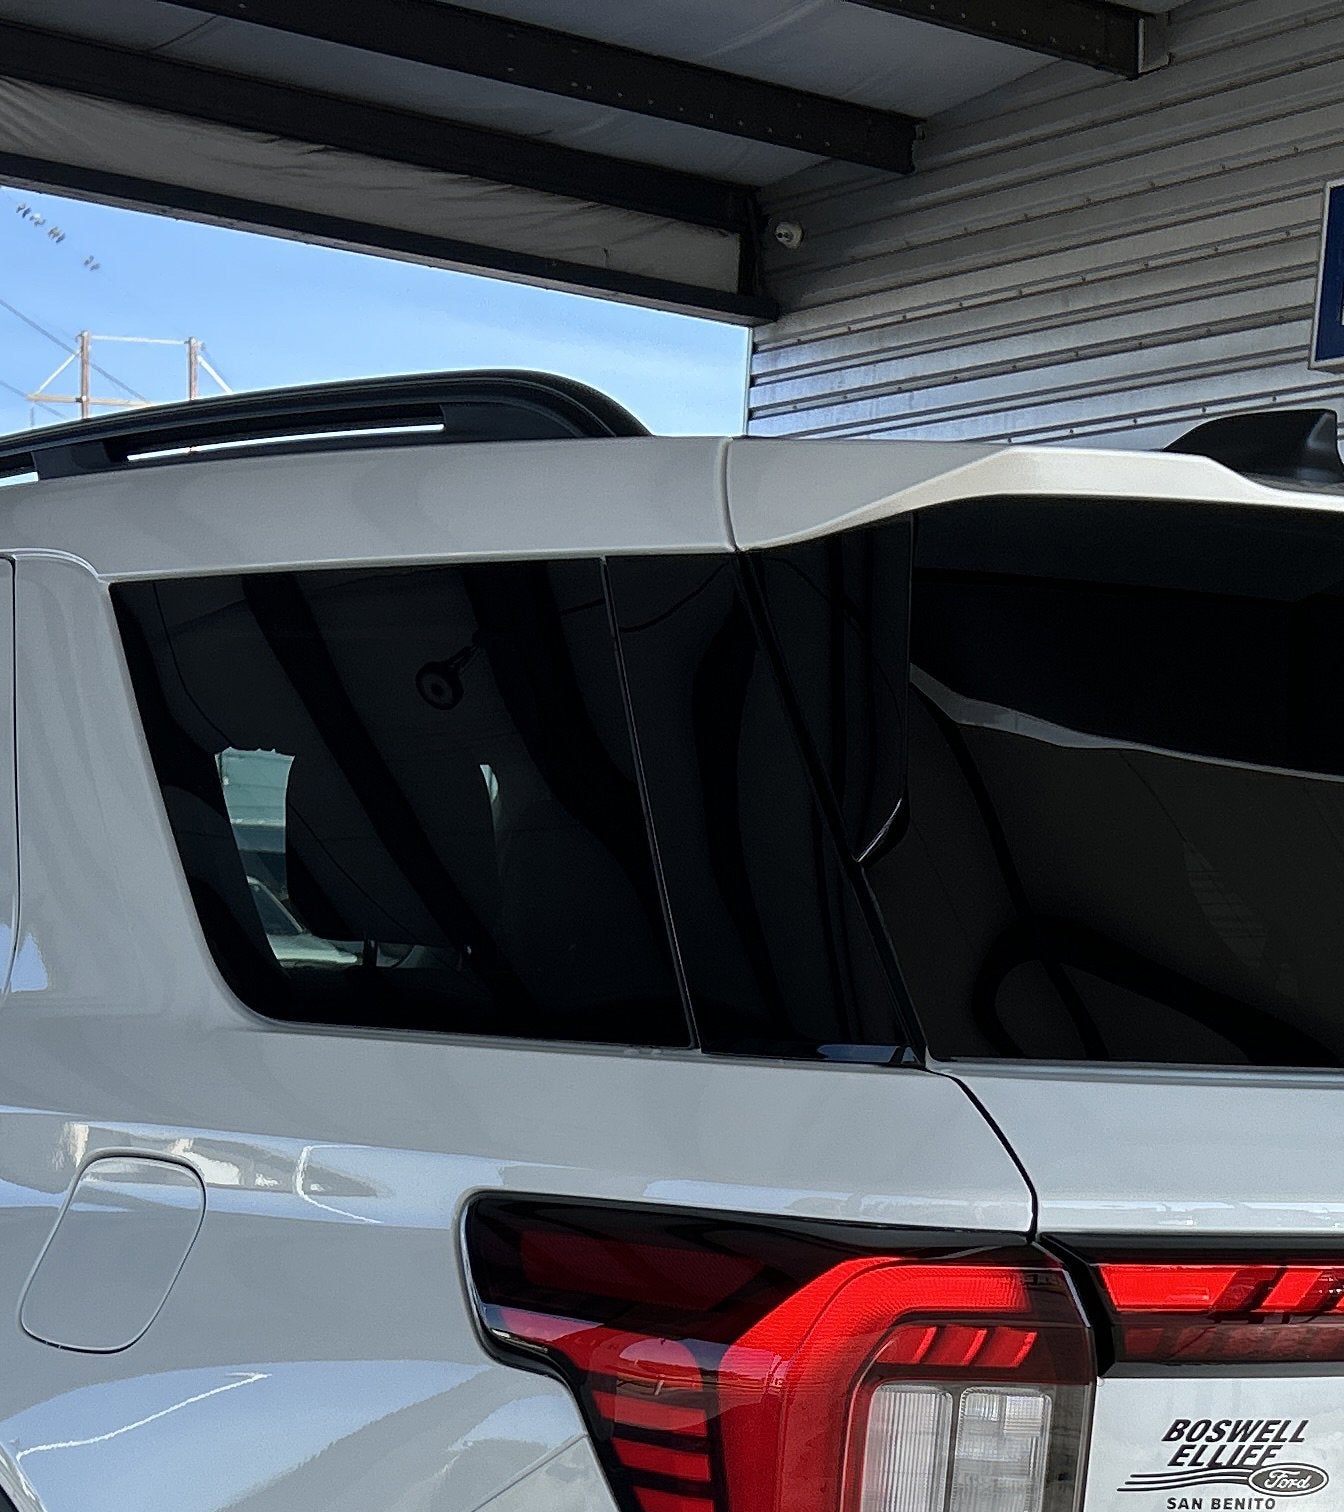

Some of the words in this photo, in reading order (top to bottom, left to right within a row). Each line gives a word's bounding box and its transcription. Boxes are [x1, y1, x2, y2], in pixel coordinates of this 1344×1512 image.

[1161, 1418, 1309, 1443] BOSWELL
[1167, 1444, 1284, 1468] ELLIFF
[1264, 1469, 1312, 1489] Ford
[1166, 1497, 1203, 1510] SAN
[1210, 1497, 1276, 1510] BENITO
